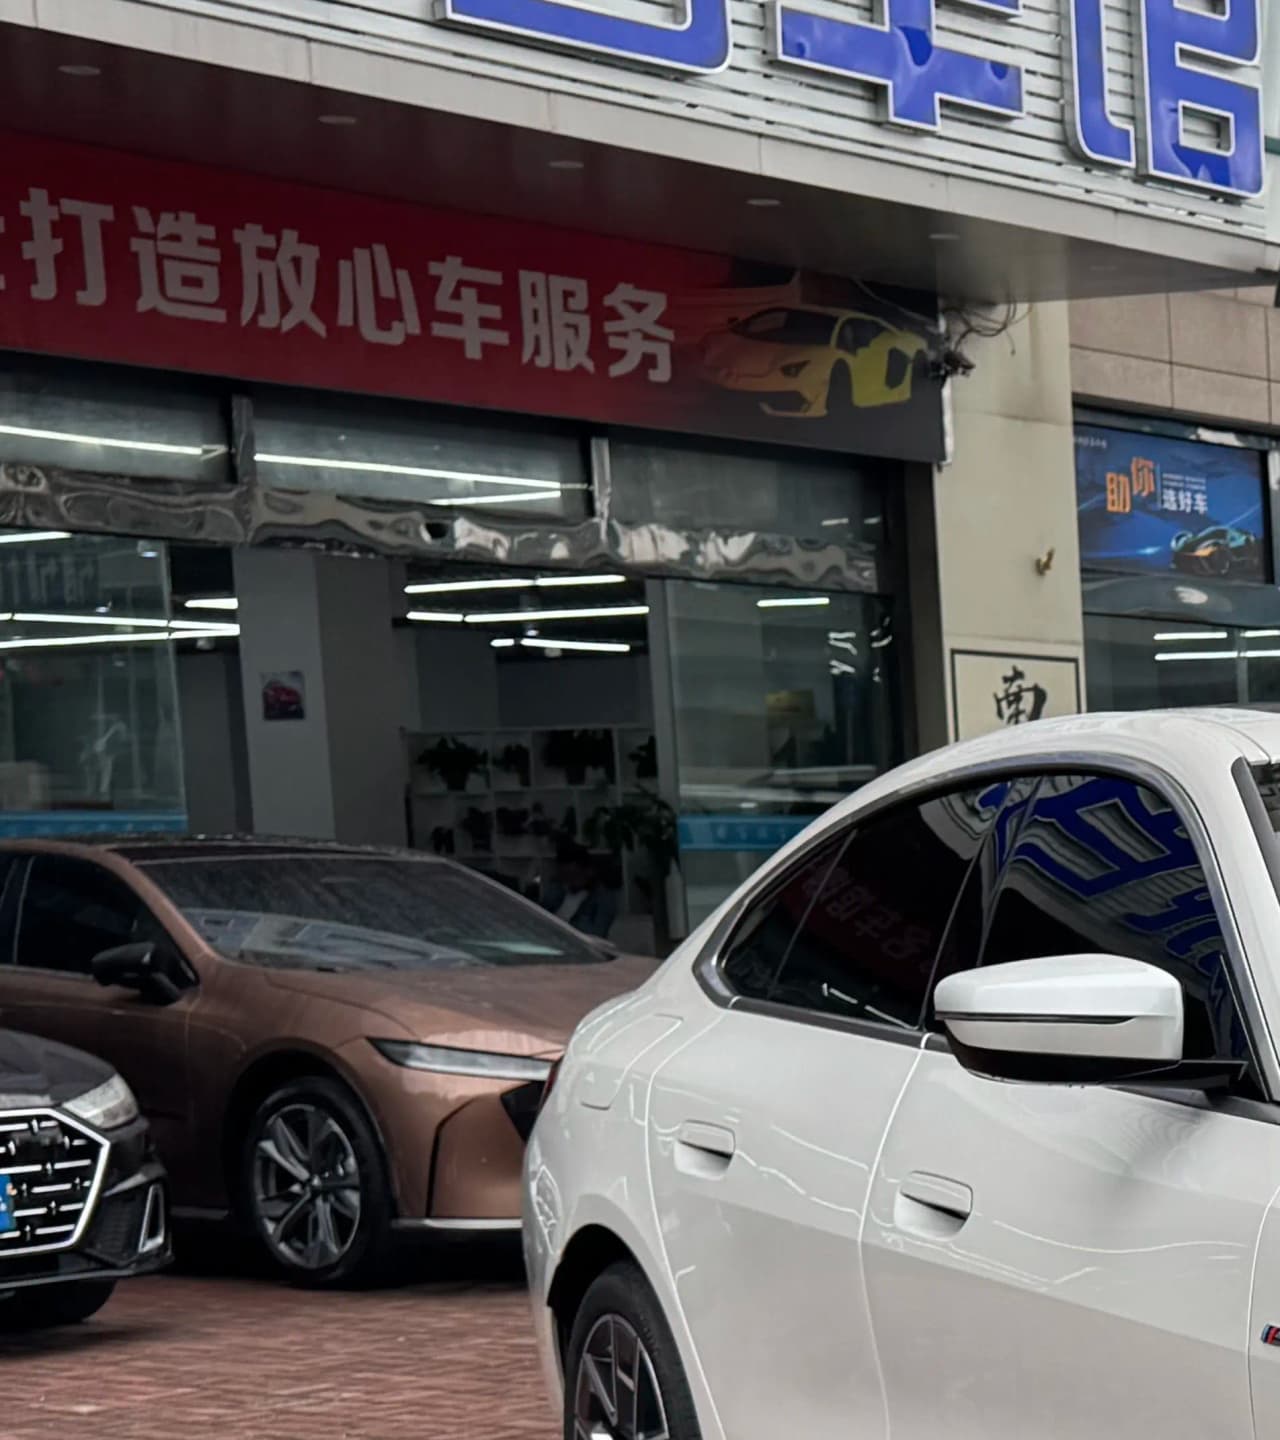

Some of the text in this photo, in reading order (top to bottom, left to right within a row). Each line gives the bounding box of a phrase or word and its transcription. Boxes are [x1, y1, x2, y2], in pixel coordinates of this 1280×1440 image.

[0, 187, 675, 383] 打造放心车服务
